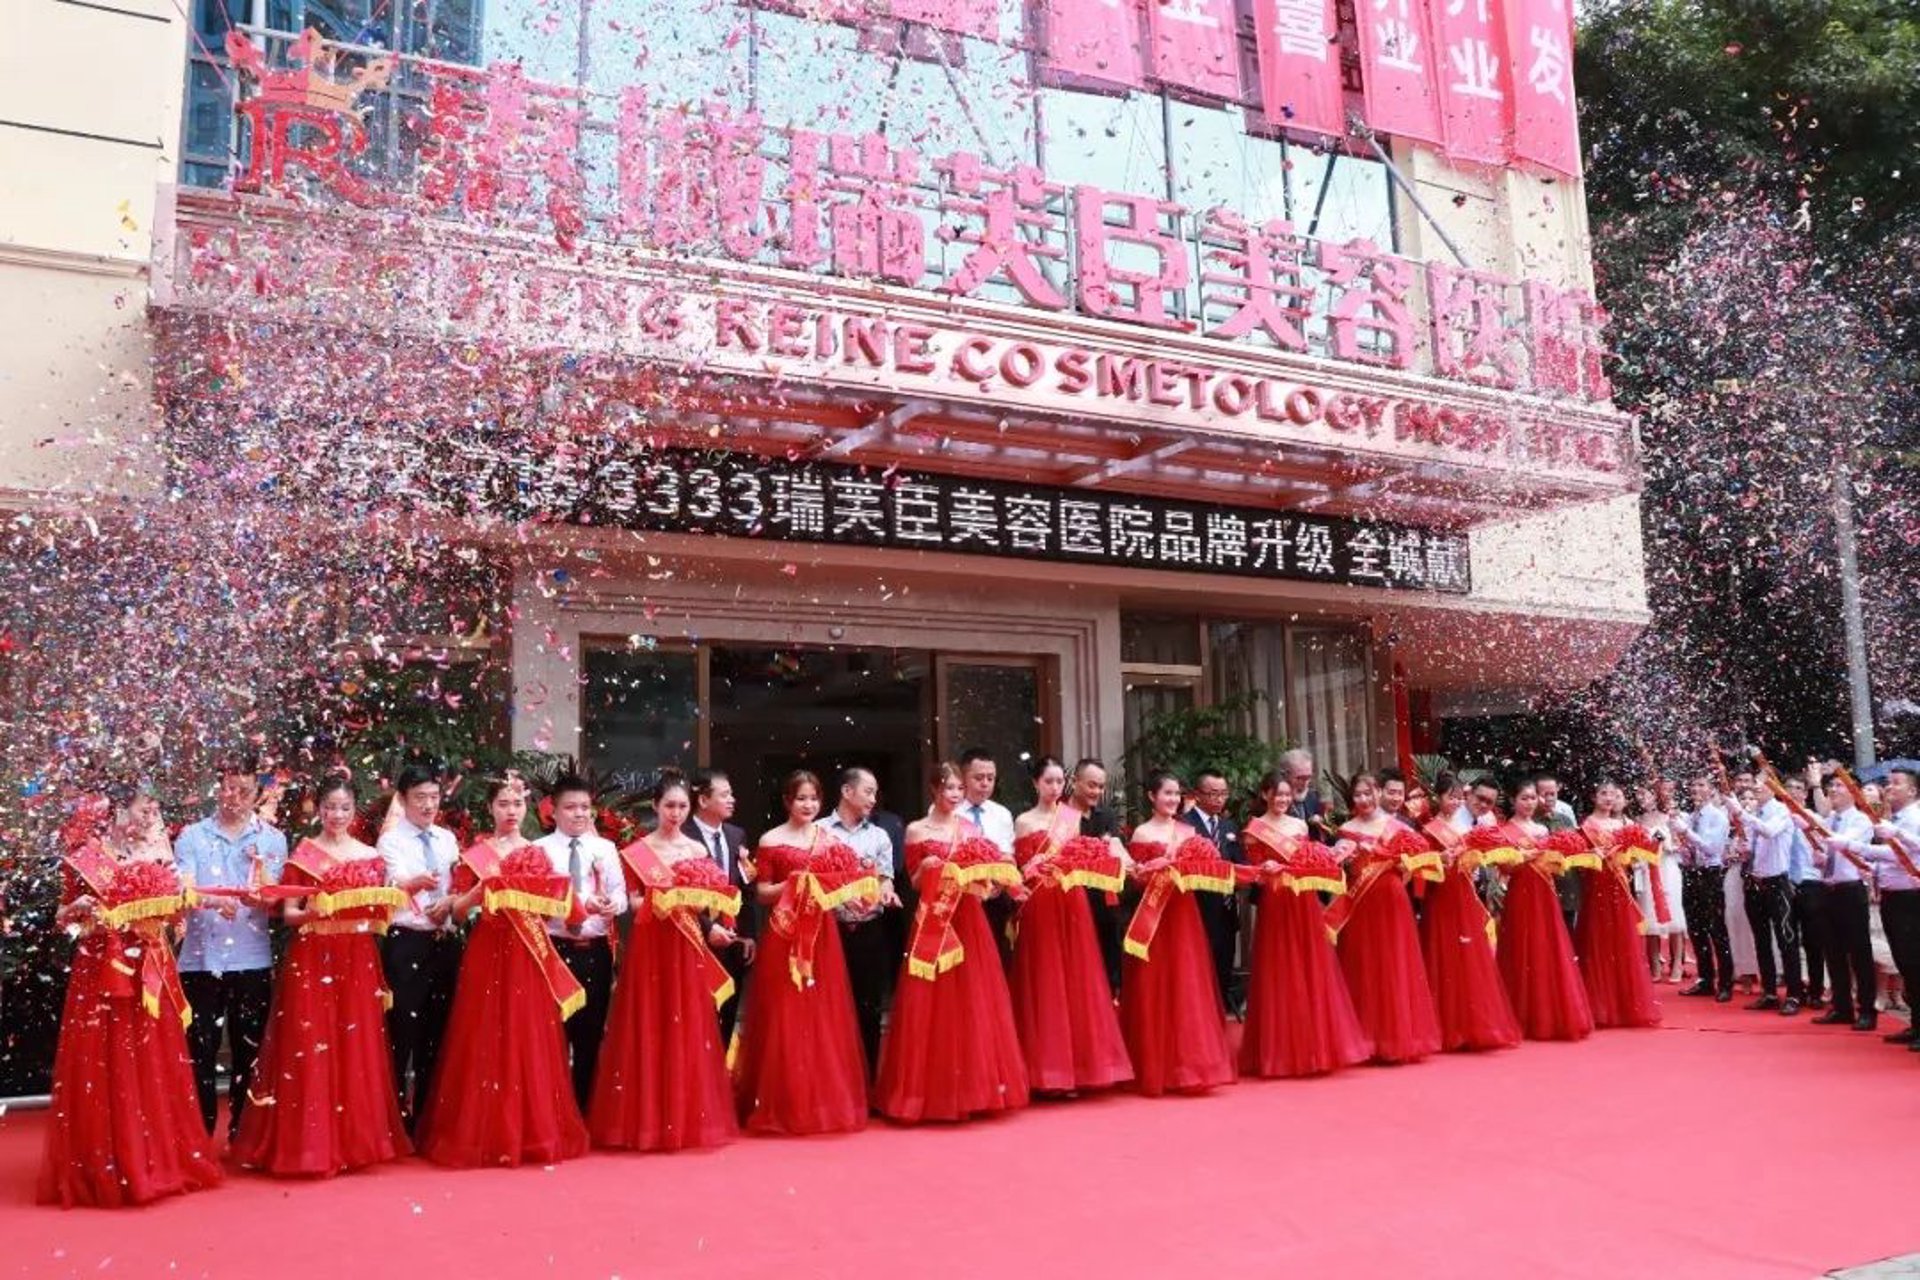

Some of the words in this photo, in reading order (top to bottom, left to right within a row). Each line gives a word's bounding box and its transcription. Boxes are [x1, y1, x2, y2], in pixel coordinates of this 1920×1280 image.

[1528, 0, 1567, 107] 发
[715, 298, 937, 375] REINE
[952, 336, 1388, 441] COSMETOLOGY
